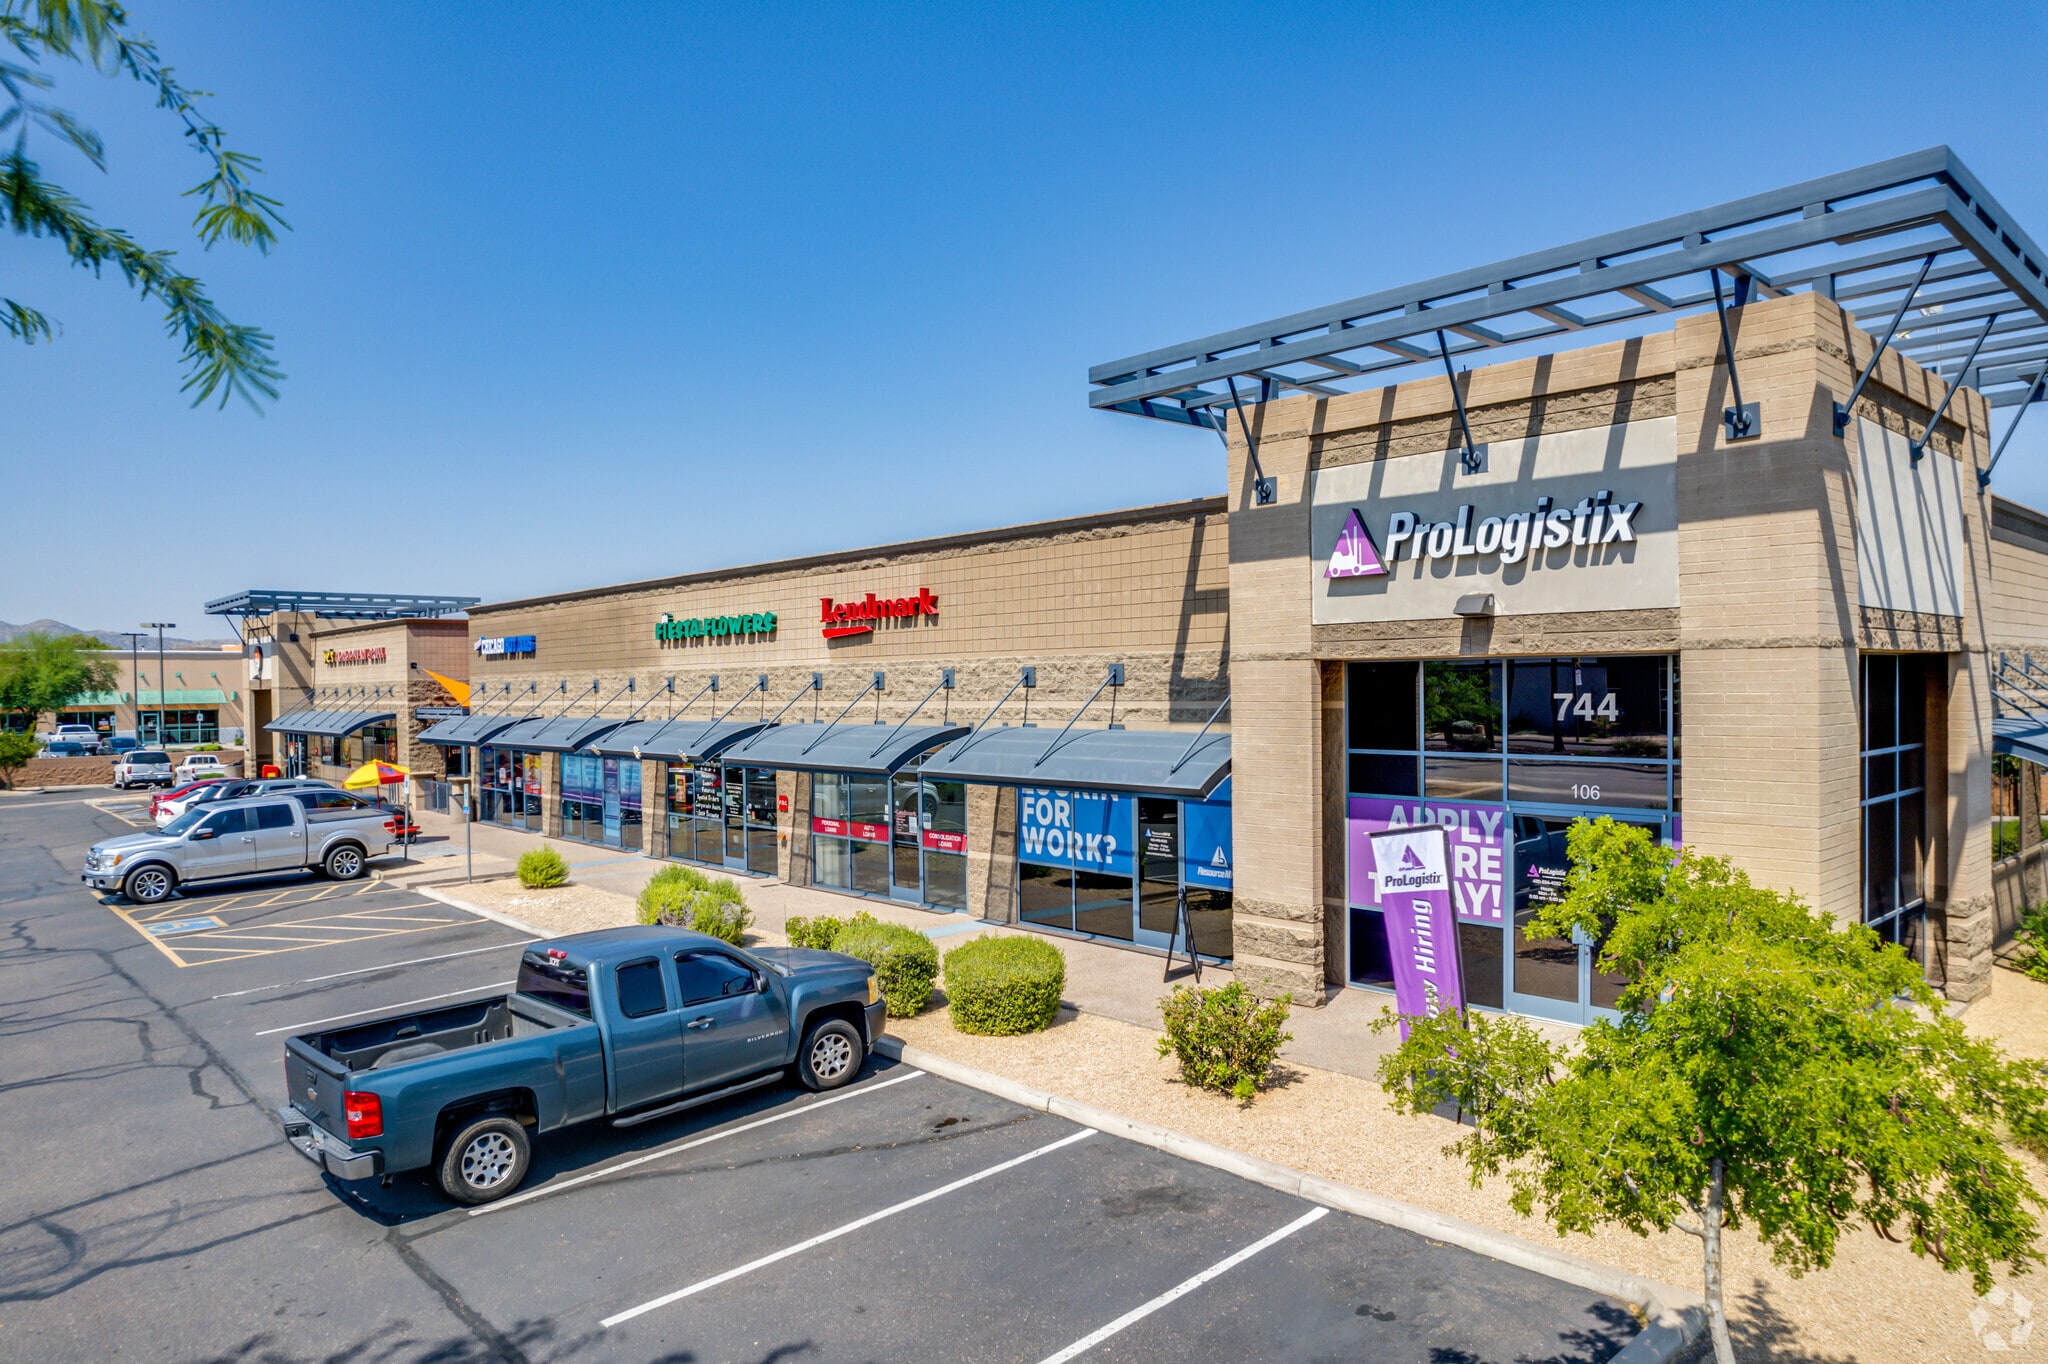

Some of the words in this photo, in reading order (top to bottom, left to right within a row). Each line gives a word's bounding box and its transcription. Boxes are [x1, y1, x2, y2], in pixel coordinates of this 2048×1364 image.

[1385, 490, 1643, 564] ProLogistix
[820, 588, 938, 623] Lendmark
[656, 617, 699, 640] FIESTA
[703, 612, 777, 637] FLOWERS
[1553, 692, 1619, 722] 744
[1571, 784, 1600, 800] 106
[1022, 797, 1071, 828] FOR
[1388, 805, 1502, 844] APPLY
[1022, 826, 1117, 864] WORK?
[1385, 872, 1443, 888] ProLogistix
[1410, 898, 1437, 974] Hiring
